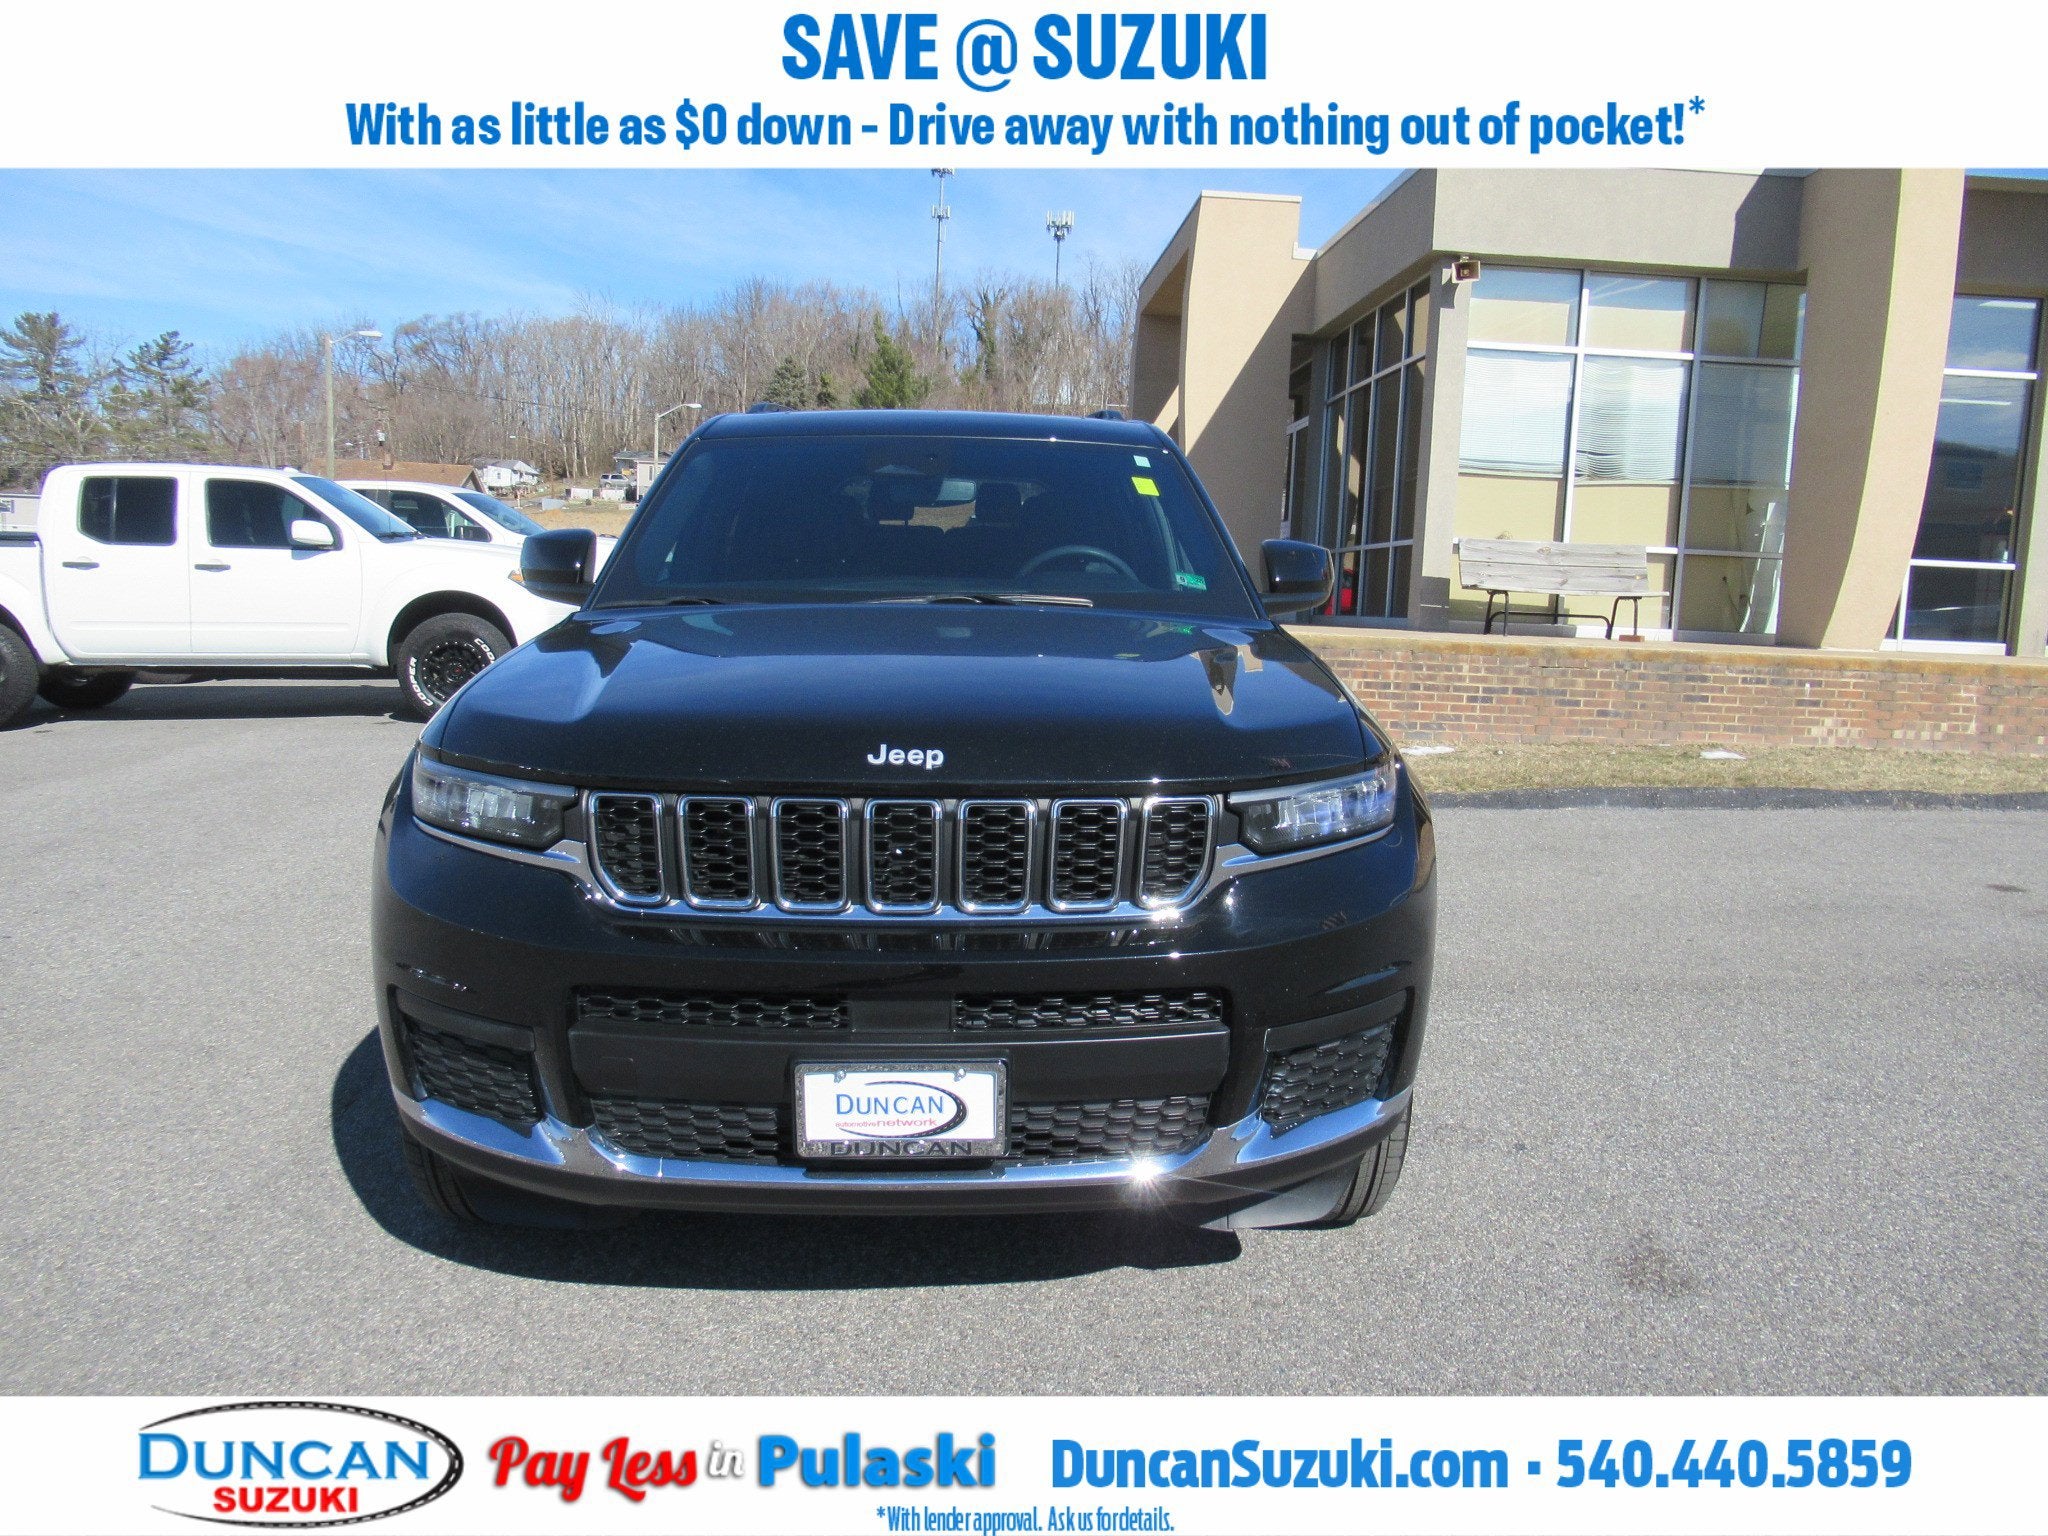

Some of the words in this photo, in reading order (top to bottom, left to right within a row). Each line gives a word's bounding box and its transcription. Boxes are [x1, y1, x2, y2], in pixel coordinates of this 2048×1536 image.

[867, 744, 944, 770] Jeep
[835, 1093, 944, 1115] DUNCAN
[831, 1141, 972, 1155] DUNCAN
